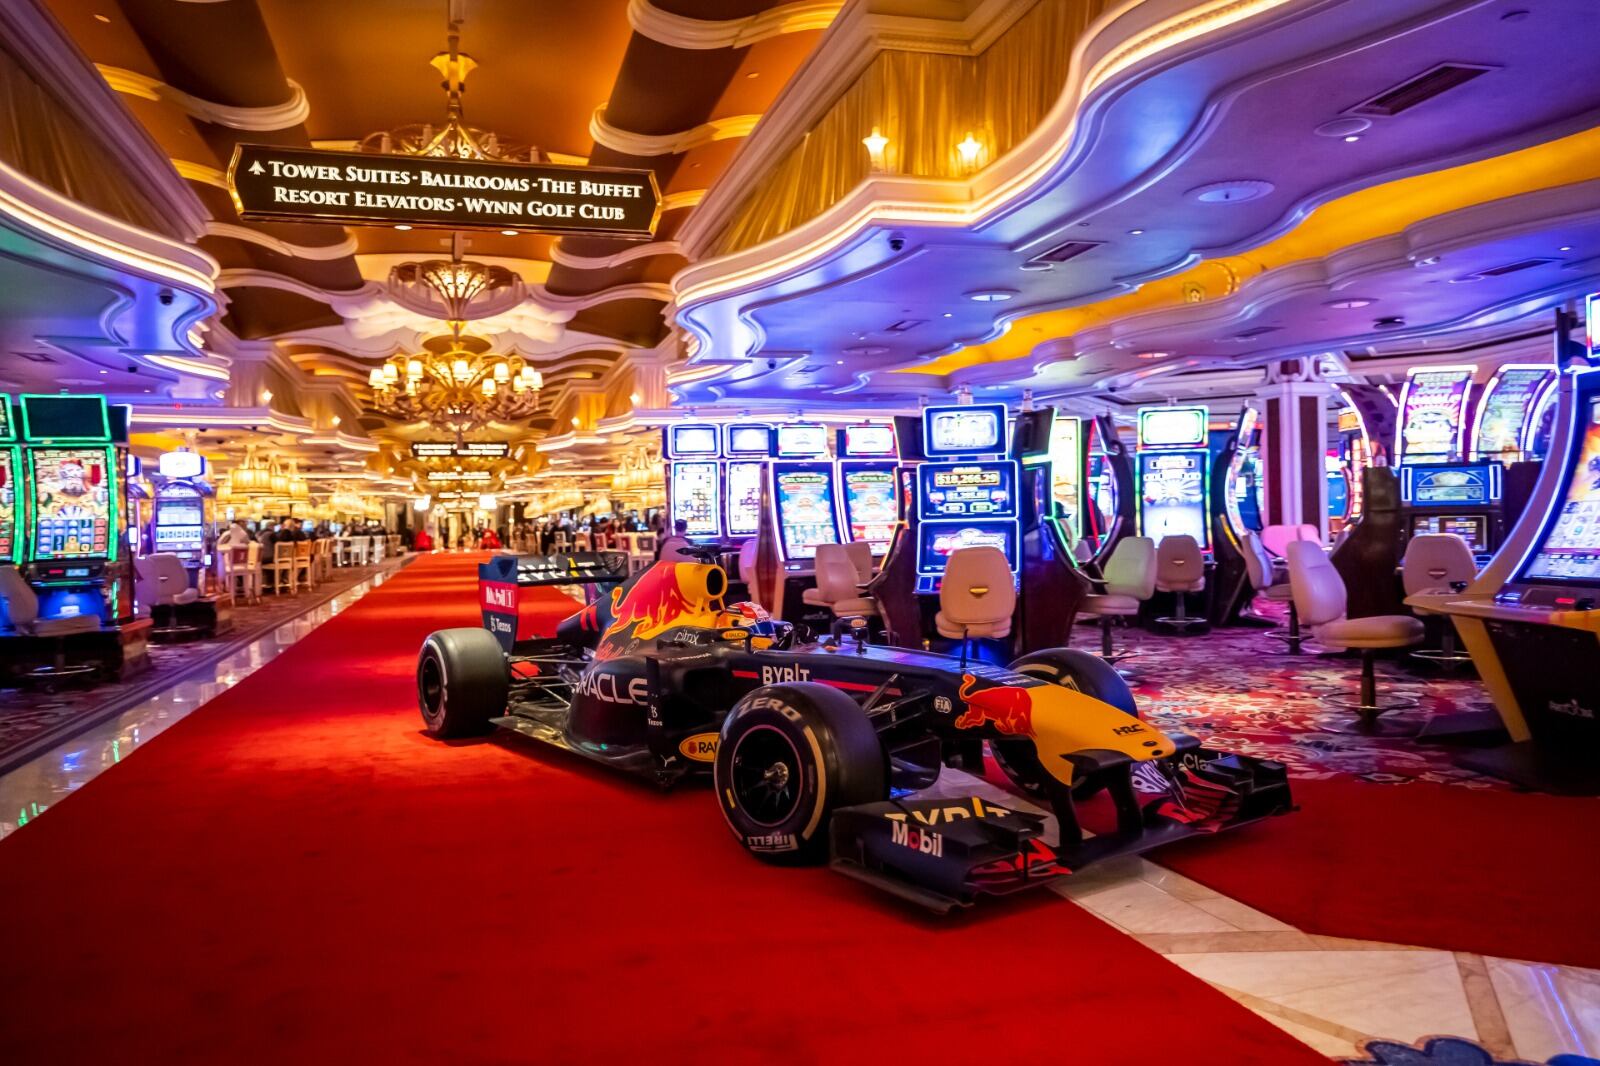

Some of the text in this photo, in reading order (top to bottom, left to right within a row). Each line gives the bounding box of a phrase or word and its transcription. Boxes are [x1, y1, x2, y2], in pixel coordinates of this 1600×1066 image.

[267, 160, 643, 198] TOWER SUITES BALLROOMS THE BUFFET
[273, 186, 625, 220] RESORT ELEVATORS WYNN GOLF CLUB
[674, 628, 700, 646] citrix
[762, 663, 810, 685] BYBIT
[737, 697, 802, 721] ZERO
[891, 820, 943, 858] Mobil
